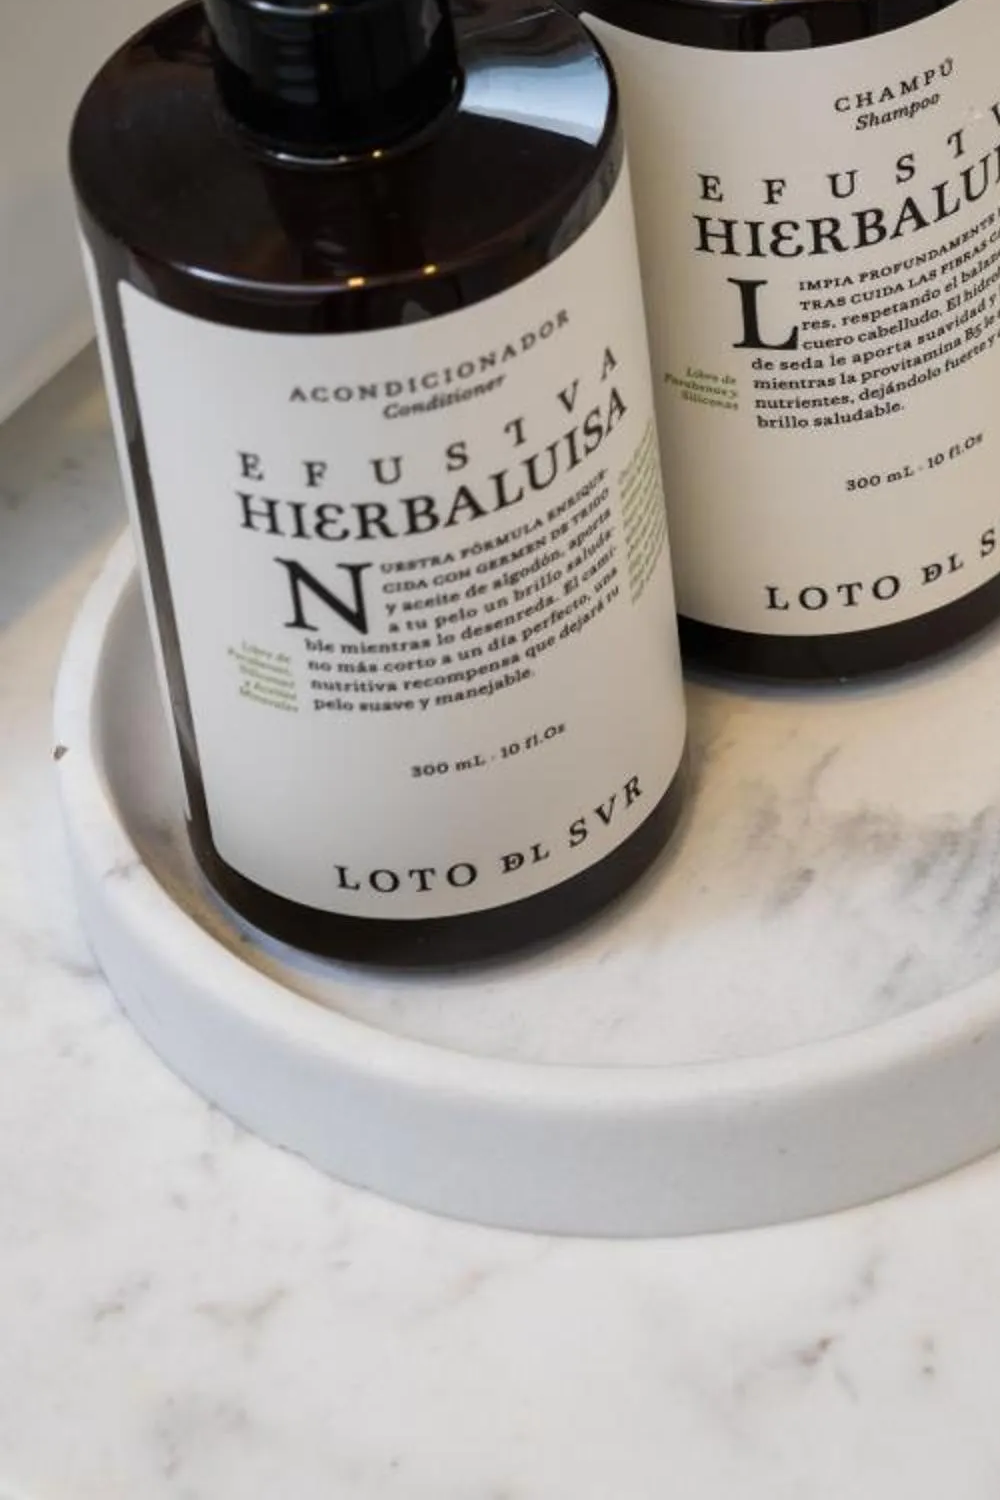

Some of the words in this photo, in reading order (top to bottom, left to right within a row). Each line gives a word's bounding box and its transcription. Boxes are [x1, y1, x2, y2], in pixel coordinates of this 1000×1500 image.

[833, 56, 954, 113] CHAMPÚ
[854, 93, 941, 131] Shampoo
[799, 297, 846, 312] TRAS
[850, 283, 904, 304] CUIDA
[908, 269, 938, 292] LAS
[940, 240, 988, 274] FIBRAS
[858, 212, 995, 283] PROFUNDAMENTE
[802, 334, 854, 351] cuero
[857, 309, 943, 344] cabelludo.
[946, 295, 961, 312] El
[841, 287, 941, 327] respetando
[944, 275, 958, 294] el
[289, 308, 570, 403] ACONDICIONADOR
[752, 356, 774, 371] de
[779, 356, 823, 371] seda
[829, 351, 846, 368] le
[851, 338, 912, 365] aporta
[917, 297, 986, 344] suavidad
[752, 375, 836, 390] mientras
[840, 372, 857, 386] la
[860, 337, 961, 385] provitamina
[965, 323, 982, 341] B5
[382, 373, 506, 421] Conditioner
[755, 395, 855, 410] nutrientes,
[859, 367, 941, 401] dejándolo
[944, 342, 986, 372] fuerte
[756, 415, 809, 429] brillo
[813, 402, 905, 427] saludable.
[845, 475, 881, 492] 300
[887, 465, 914, 483] mL
[927, 453, 945, 470] 10
[382, 580, 428, 594] CIDA
[433, 568, 471, 586] CON
[476, 536, 547, 574] GERMEN
[550, 522, 568, 542] DE
[384, 601, 397, 616] y
[403, 591, 460, 612] aceite
[465, 583, 488, 599] de
[569, 508, 610, 550] aporta
[461, 518, 543, 558] FÓRMULA
[304, 638, 334, 653] ble
[340, 636, 431, 654] mientras
[436, 632, 455, 647] lo
[563, 576, 579, 596] El
[308, 660, 332, 672] no
[337, 658, 378, 673] más
[383, 653, 436, 673] corto
[441, 655, 452, 665] a
[458, 646, 483, 660] un
[487, 634, 516, 653] día
[593, 566, 617, 594] una
[388, 620, 401, 632] a
[406, 618, 427, 632] tu
[434, 607, 477, 629] pelo
[484, 598, 508, 614] un
[513, 569, 562, 604] brillo
[765, 574, 901, 612] LOTO
[311, 678, 397, 693] nutritiva
[403, 653, 520, 692] recompensa
[525, 636, 556, 659] que
[313, 698, 353, 712] pelo
[359, 699, 414, 712] suave
[419, 697, 430, 710] y
[410, 761, 449, 778] 300
[455, 753, 486, 772] mL
[500, 743, 521, 759] 10
[334, 862, 478, 894] LOTO
[568, 774, 643, 849] SVR
